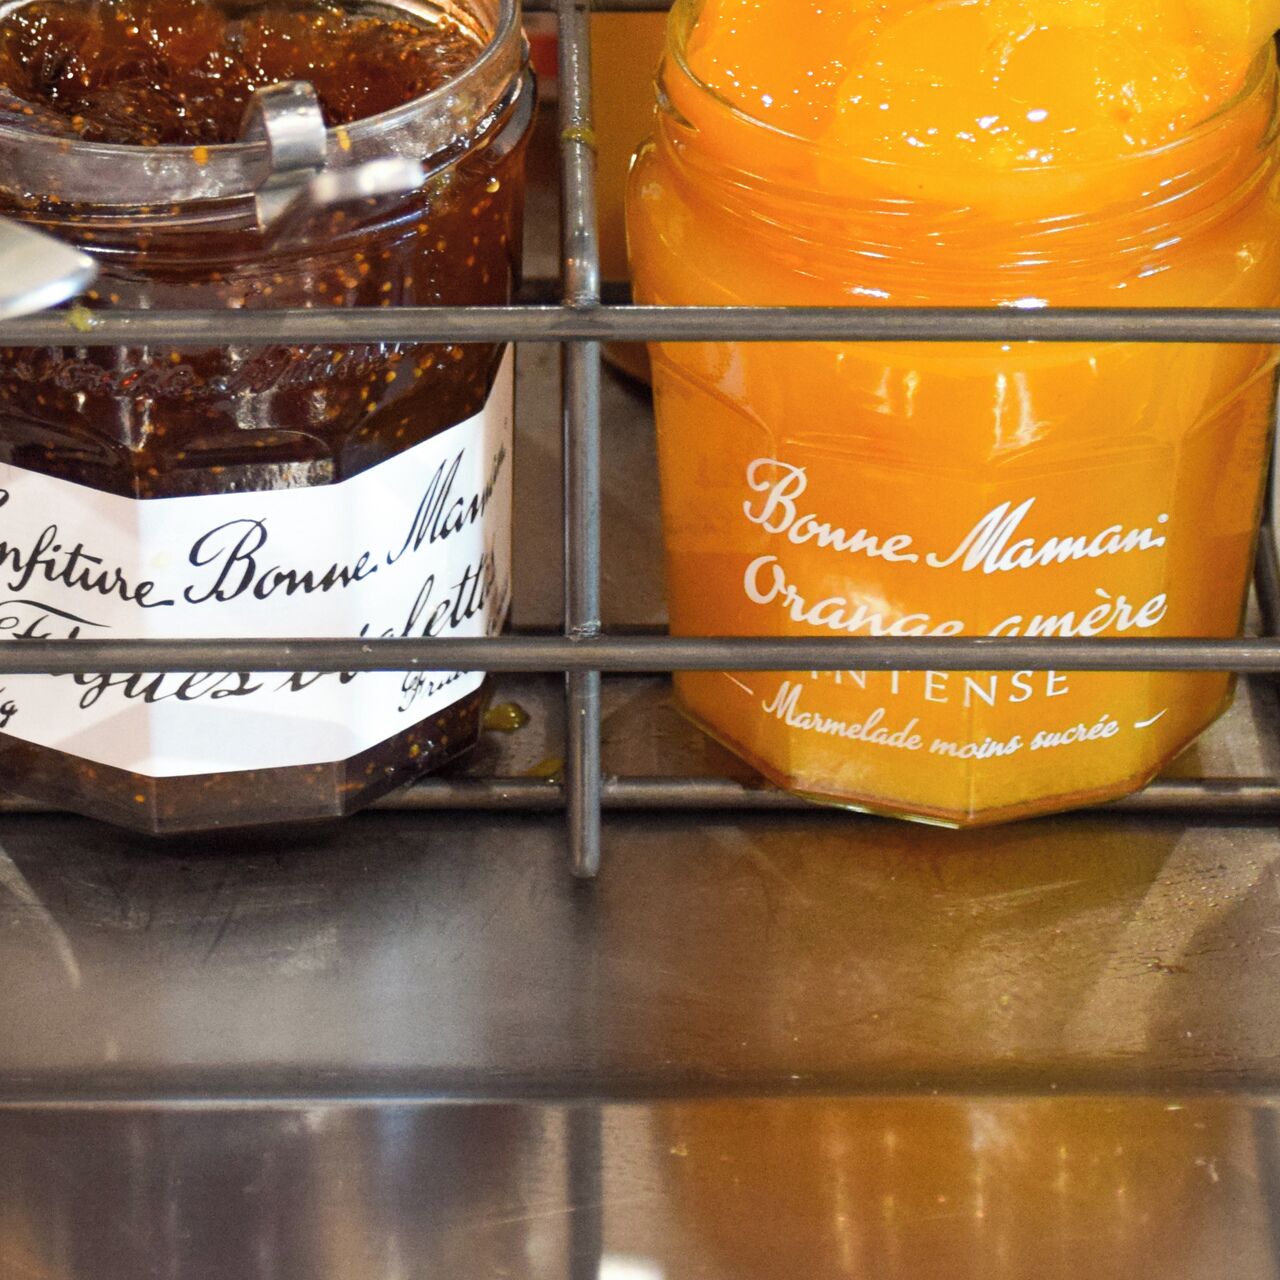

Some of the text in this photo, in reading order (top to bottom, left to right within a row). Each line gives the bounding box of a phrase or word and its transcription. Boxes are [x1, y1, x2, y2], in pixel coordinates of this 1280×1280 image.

[742, 457, 919, 564] Bonne
[183, 517, 379, 604] Bonne
[762, 680, 1120, 761] Marmelade moins sucrée
